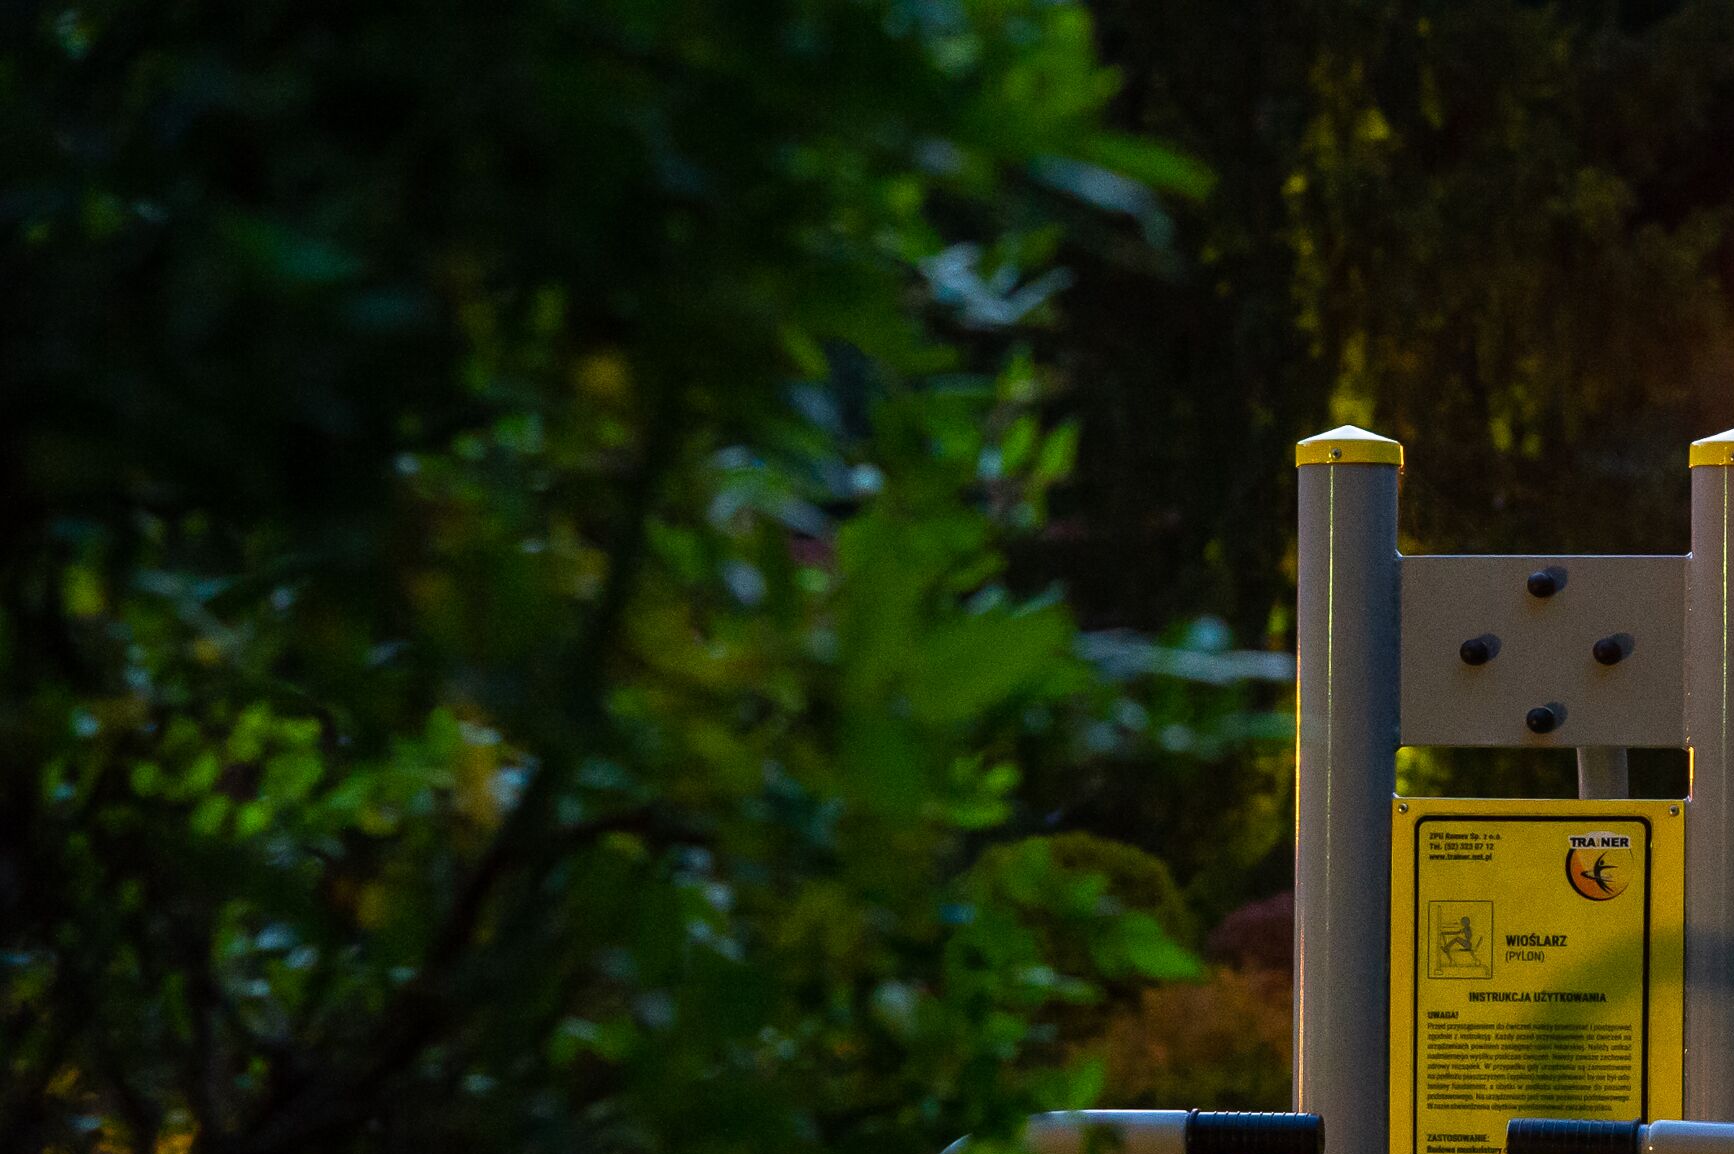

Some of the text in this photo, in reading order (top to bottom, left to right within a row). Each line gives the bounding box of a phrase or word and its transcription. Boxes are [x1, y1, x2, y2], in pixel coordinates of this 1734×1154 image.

[1505, 932, 1568, 947] WIOŚLARZ
[1505, 951, 1545, 963] (PYLON)
[1469, 990, 1607, 1002] INSTRUKCJA UŻYTKOWANIA
[1427, 1011, 1459, 1019] UWAGA!
[1427, 1133, 1490, 1142] ZASTOSOWANIE:
